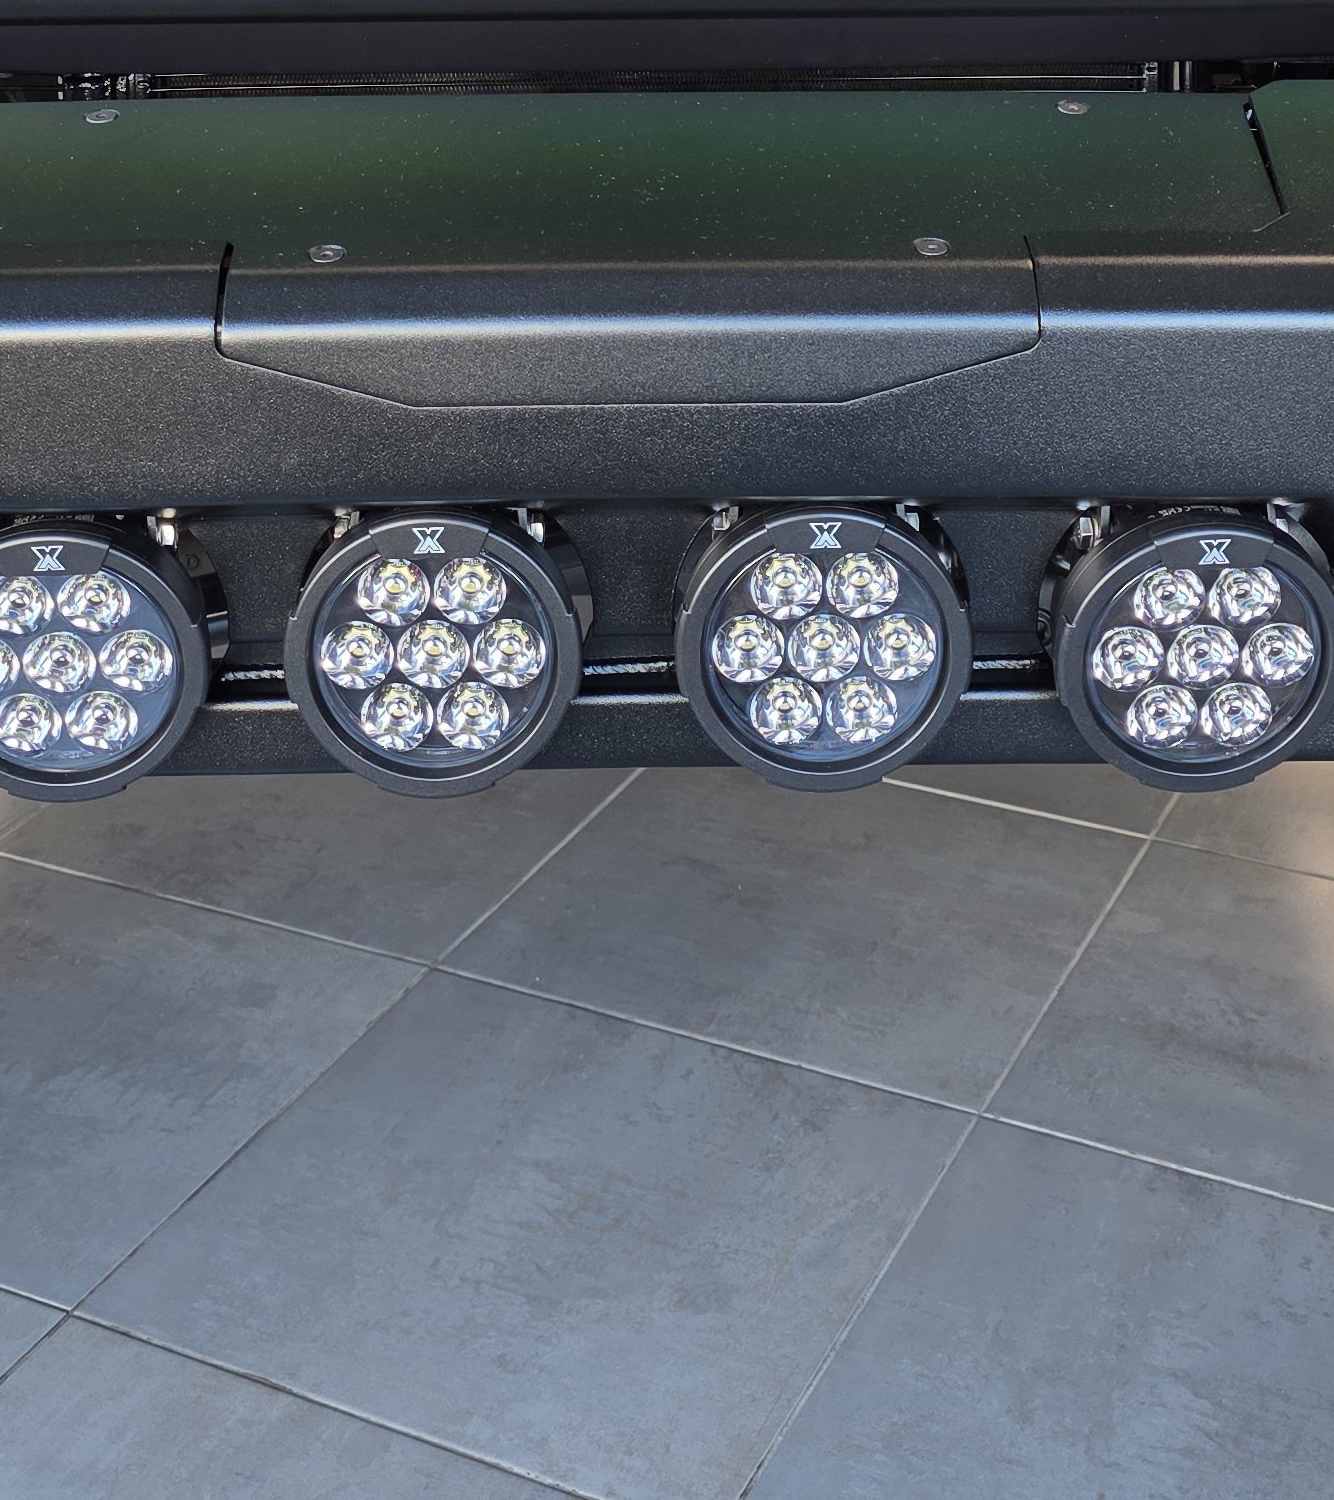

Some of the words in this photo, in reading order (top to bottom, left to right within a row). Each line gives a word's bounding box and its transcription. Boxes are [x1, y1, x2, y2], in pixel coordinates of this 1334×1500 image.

[412, 527, 445, 554] X
[809, 522, 842, 549] X
[31, 545, 65, 571] X
[1198, 539, 1231, 565] X
